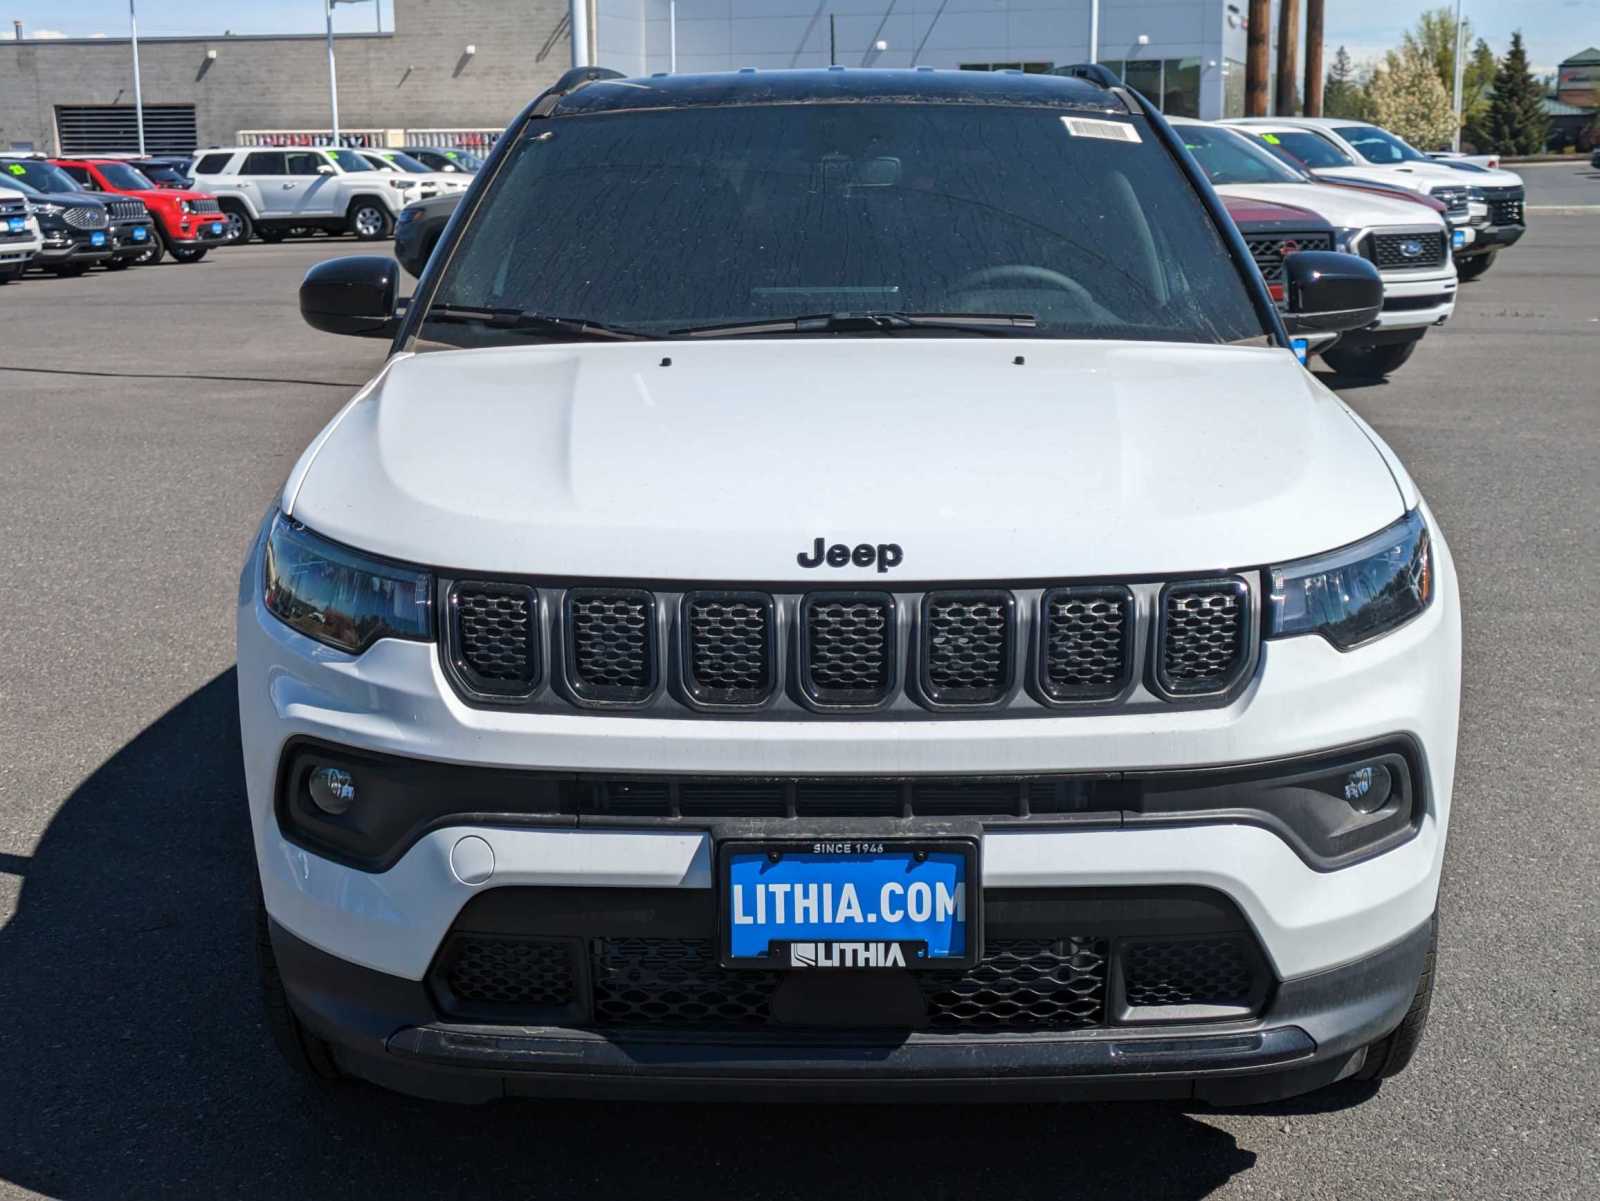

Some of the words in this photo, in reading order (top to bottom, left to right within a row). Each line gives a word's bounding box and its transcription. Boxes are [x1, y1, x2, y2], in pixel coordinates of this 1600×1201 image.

[797, 537, 904, 573] Jeep
[813, 843, 852, 854] SINCE
[855, 843, 884, 854] 1946
[733, 882, 966, 925] LITHIA.COM
[816, 943, 906, 968] LITHIA
